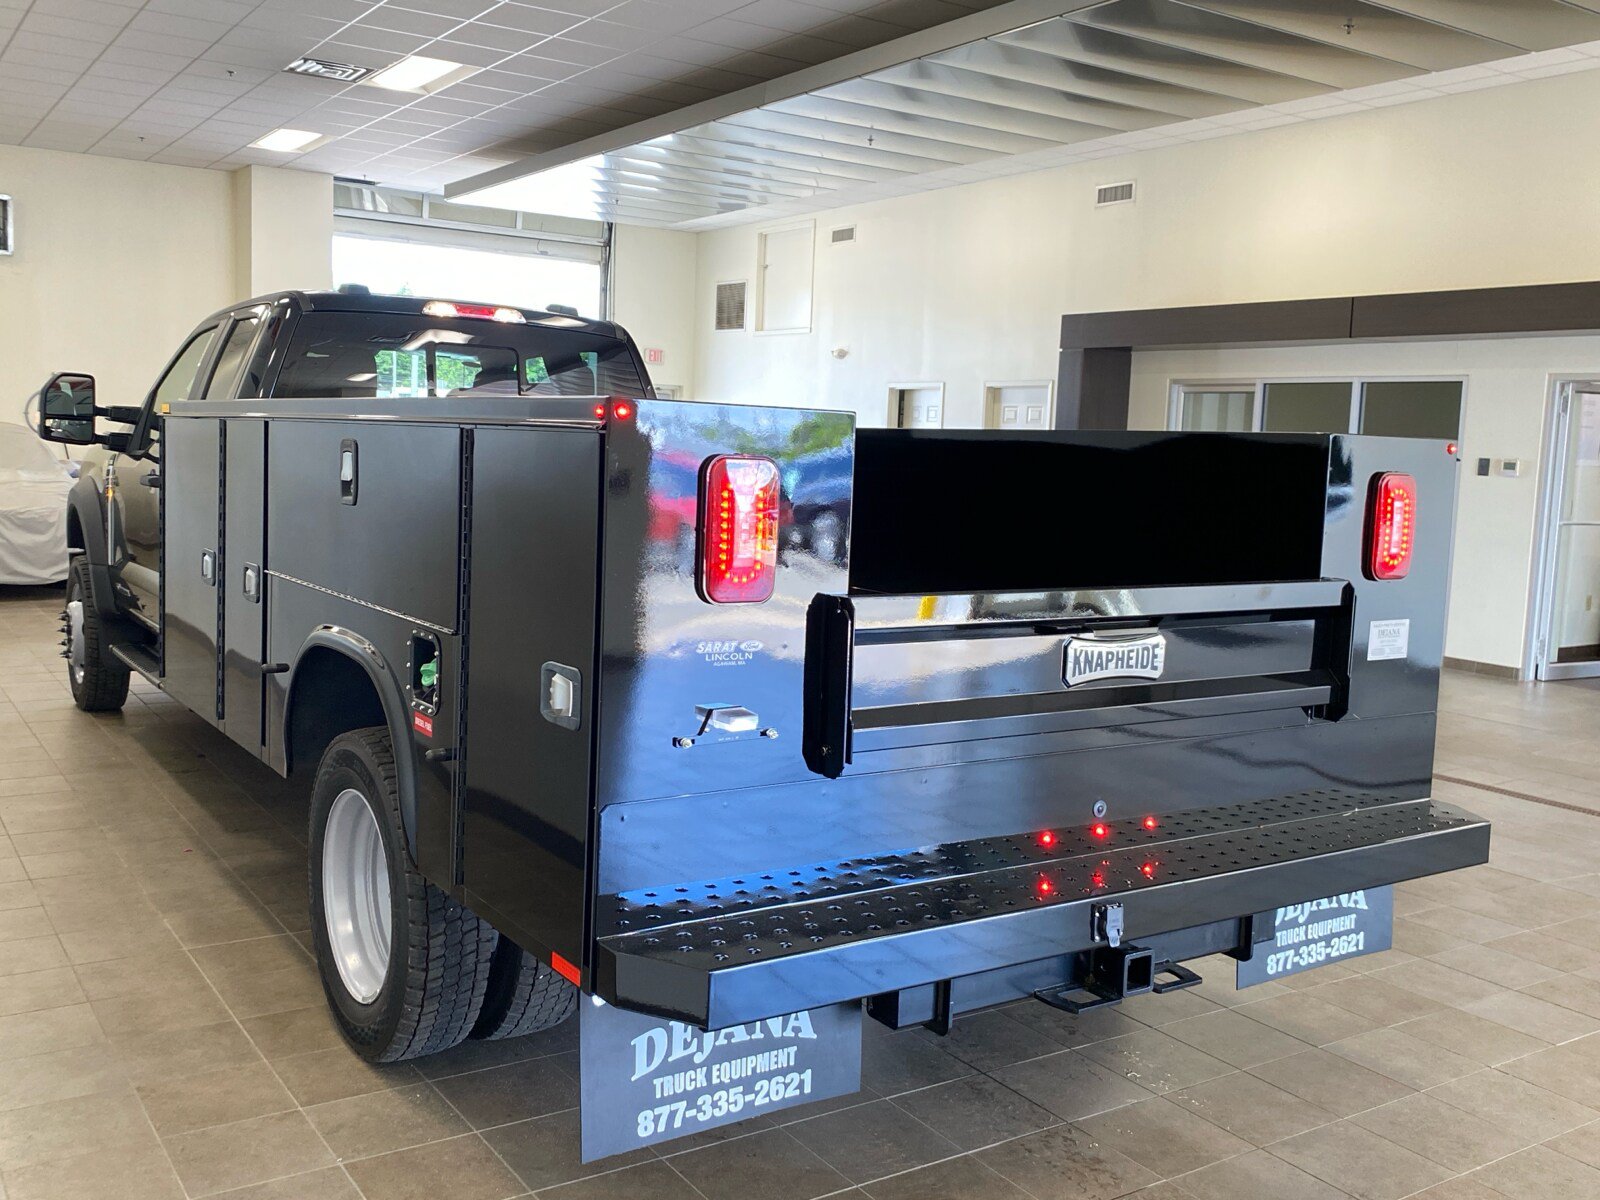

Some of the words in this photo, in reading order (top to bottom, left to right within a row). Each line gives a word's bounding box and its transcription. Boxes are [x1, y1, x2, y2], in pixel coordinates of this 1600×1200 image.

[648, 349, 663, 362] EXIT
[696, 641, 739, 654] SARAT
[705, 652, 753, 662] LINCOLN
[1072, 643, 1160, 678] KNAPHEIDE
[1276, 923, 1306, 948] TRUCK
[1307, 914, 1357, 939] EQUIPMENT
[1266, 931, 1365, 976] 877-335-2621
[630, 1010, 818, 1082] DEJANA
[653, 1066, 707, 1099] TRUCK
[712, 1046, 798, 1084] EQUIPMENT
[637, 1069, 812, 1138] 877-335-2621
